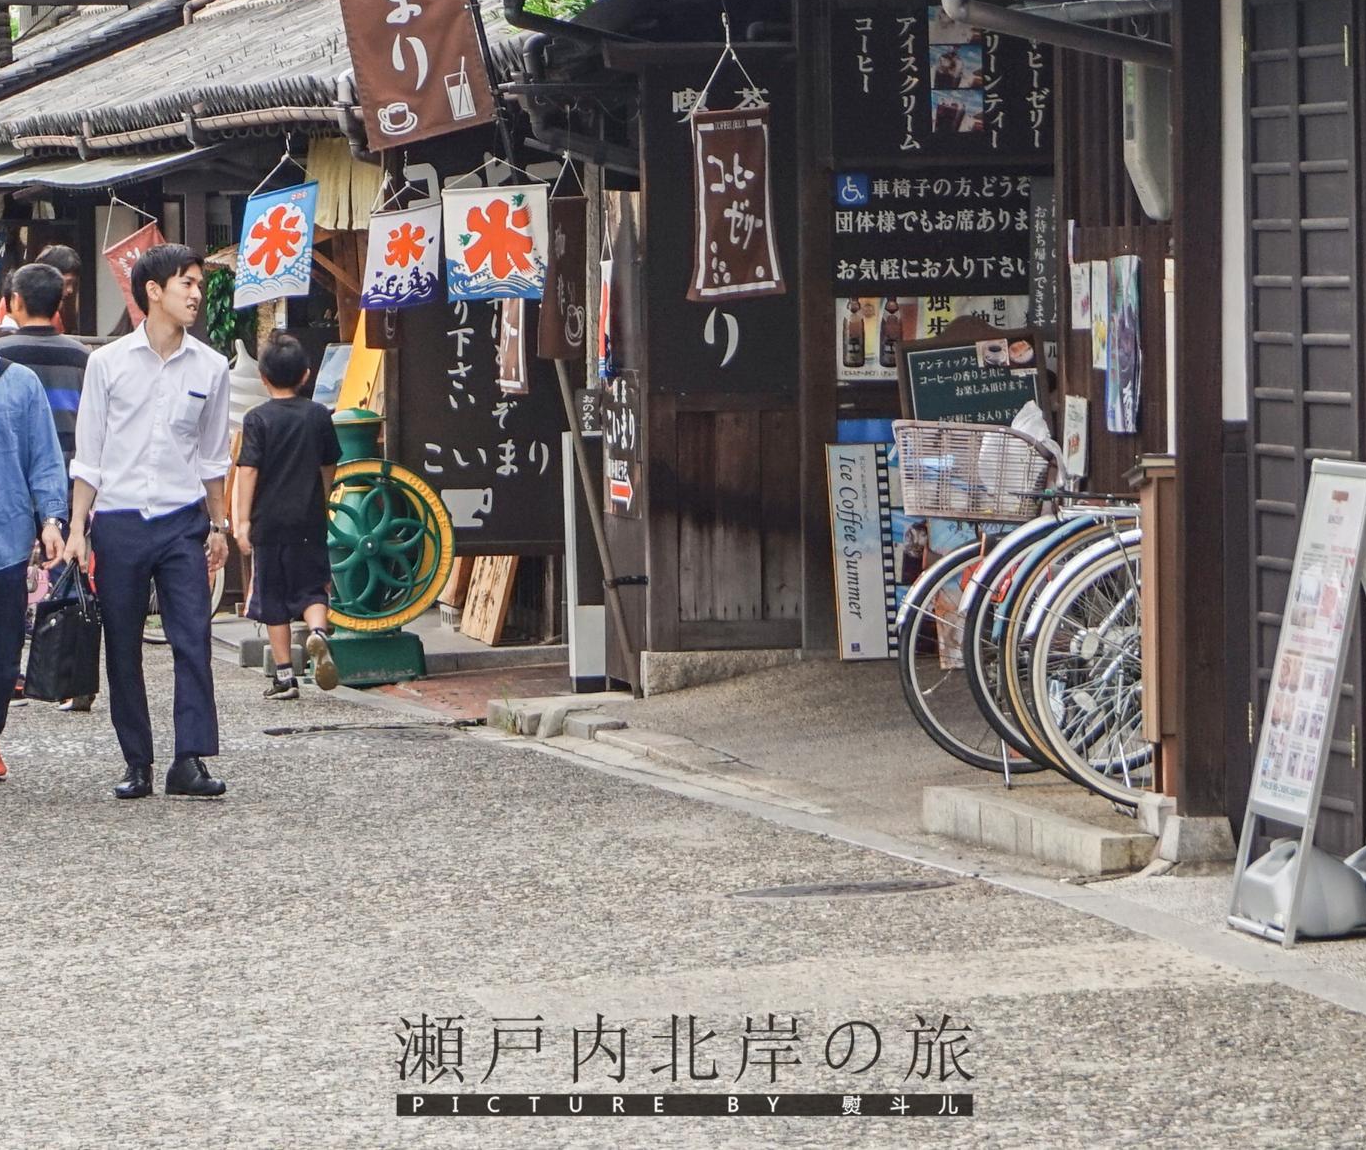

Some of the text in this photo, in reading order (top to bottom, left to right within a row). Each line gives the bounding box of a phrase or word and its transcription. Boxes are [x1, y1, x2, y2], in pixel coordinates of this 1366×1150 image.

[854, 17, 874, 94] コーヒー
[896, 17, 922, 150] アイスクリーム
[984, 28, 1005, 149] リーンティー
[1025, 39, 1051, 148] ヒーゼリー
[707, 153, 755, 193] コーヒー
[872, 176, 1031, 199] 車椅子の方、どうぞ
[723, 199, 764, 250] ゼリー
[835, 208, 1031, 234] 団体様でもお席ありま
[424, 439, 549, 475] こいまり
[836, 455, 863, 620] Ice Coffee Summer
